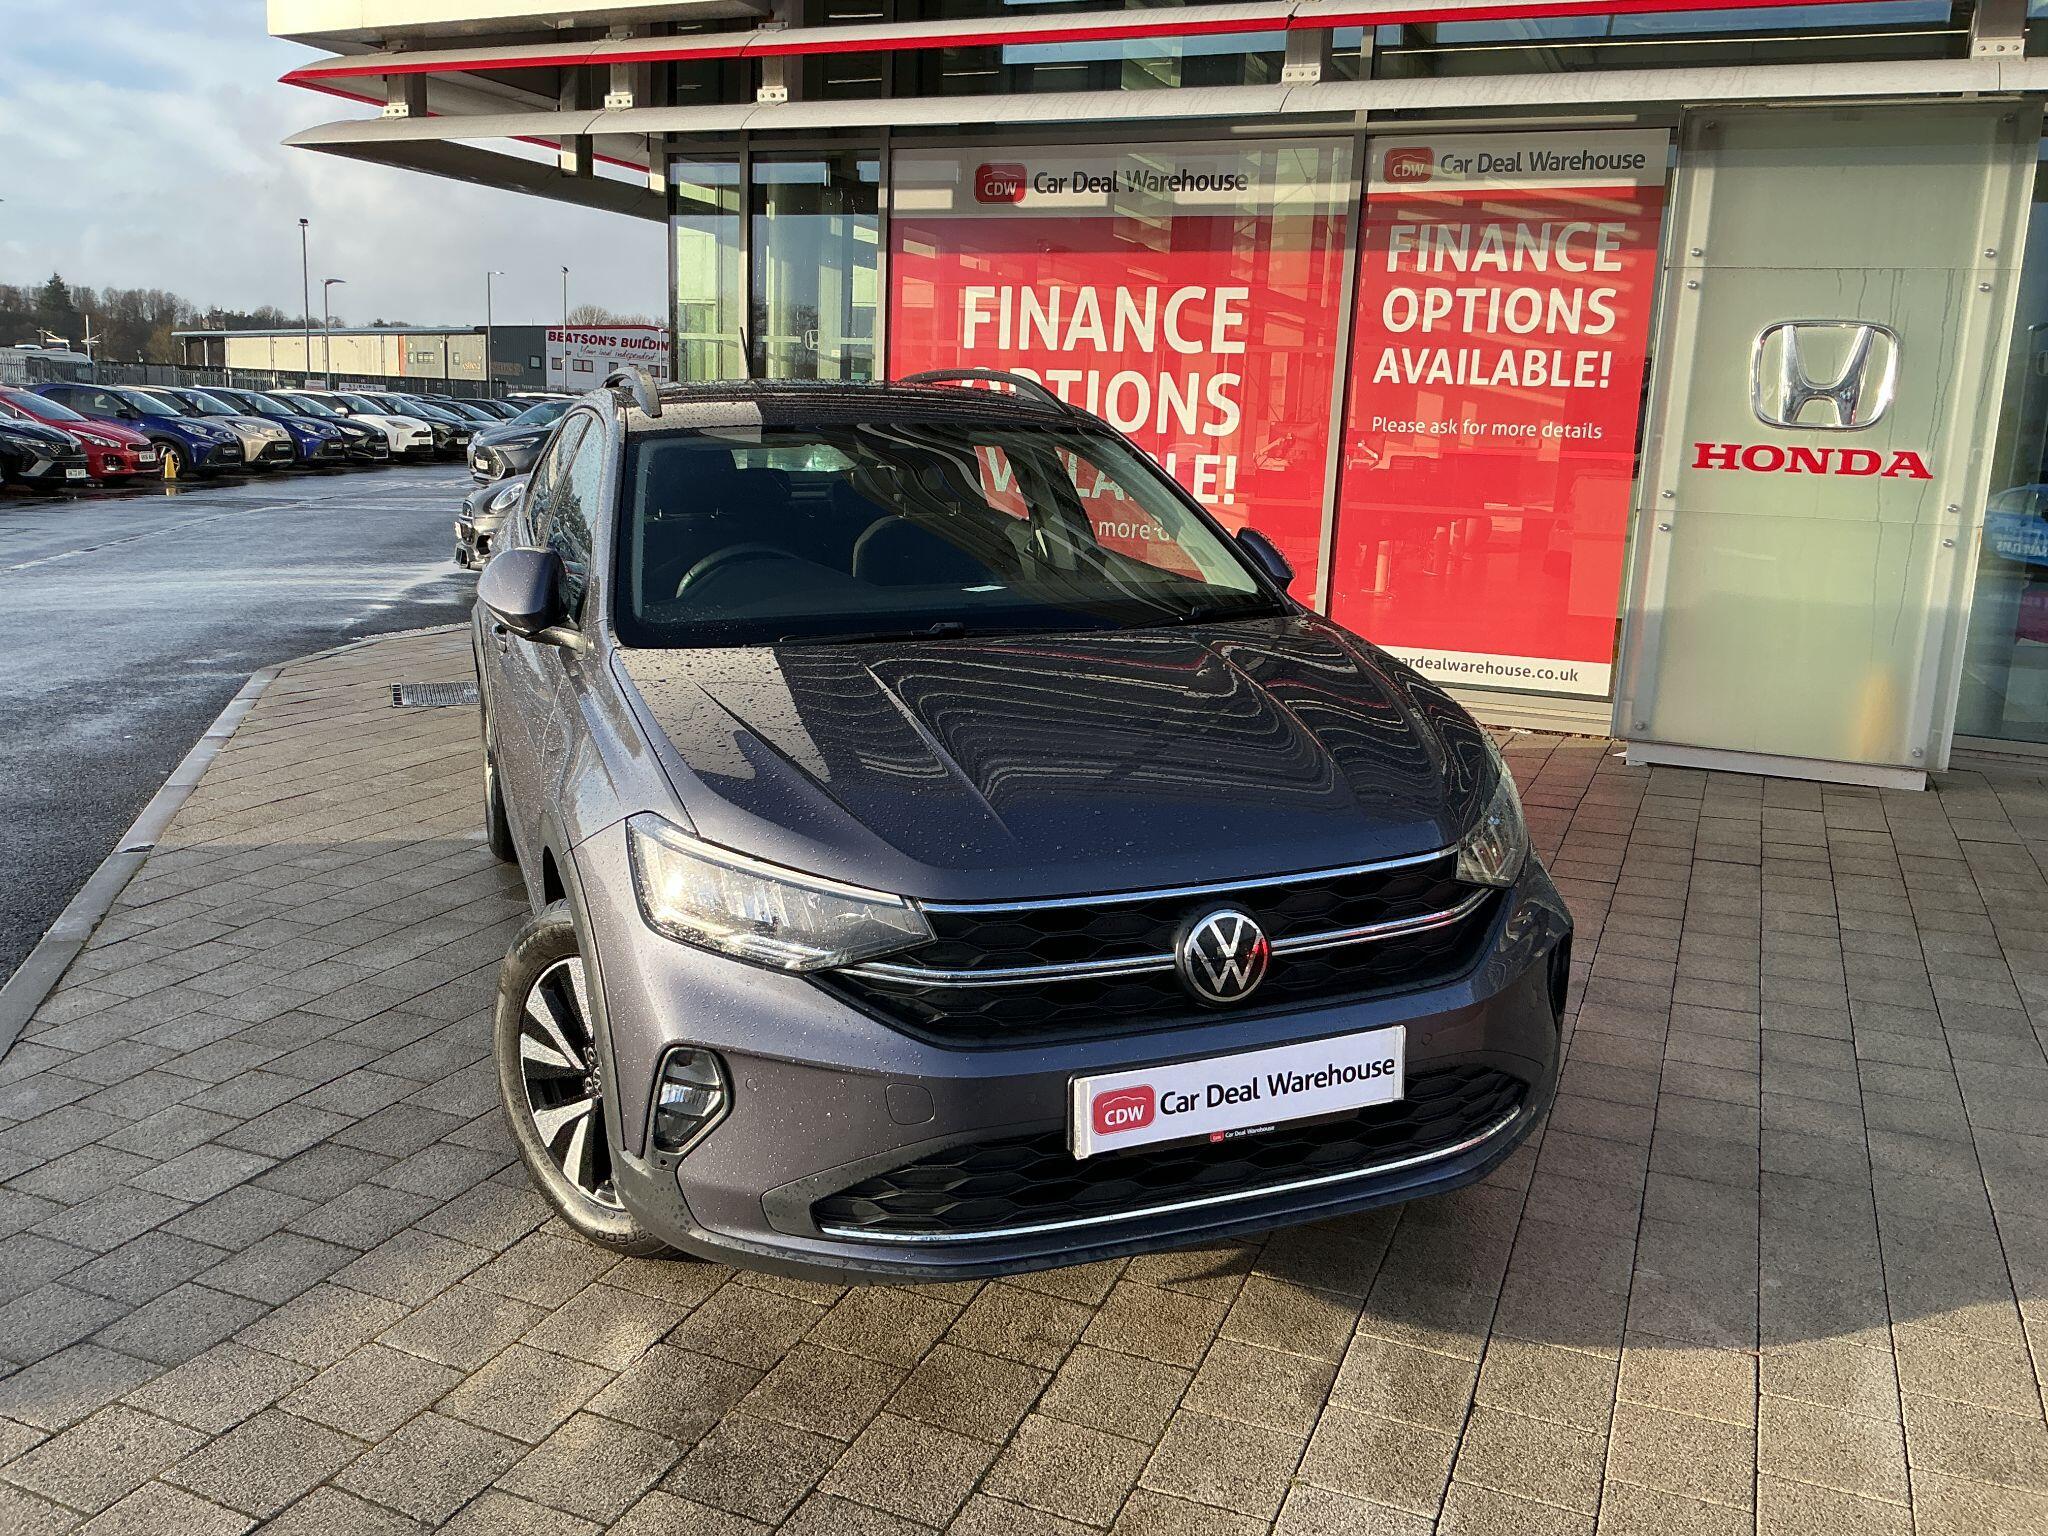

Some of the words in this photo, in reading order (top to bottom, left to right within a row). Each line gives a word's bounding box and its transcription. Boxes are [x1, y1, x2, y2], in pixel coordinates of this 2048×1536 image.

[1392, 163, 1425, 178] CDW
[1441, 154, 1473, 174] Car
[1478, 152, 1523, 173] Deal
[1530, 150, 1646, 172] Warehouse
[984, 182, 1017, 196] CDW
[1034, 172, 1067, 194] Car
[1073, 170, 1119, 194] Deal
[1126, 169, 1249, 192] Warehouse
[1386, 222, 1626, 273] FINANCE
[963, 286, 1249, 354] FINANCE
[1382, 287, 1617, 335] OPTIONS
[548, 331, 617, 347] BEATSON'S
[1373, 347, 1612, 389] AVAILABLE!
[1372, 416, 1426, 433] Please
[1430, 418, 1458, 434] ask
[1462, 418, 1487, 435] for
[1492, 422, 1537, 437] more
[1541, 421, 1602, 439] details
[1691, 443, 1934, 479] HONDA
[1098, 520, 1150, 540] more
[1395, 656, 1579, 682] ardealwarehouse.co.uk
[1104, 1104, 1145, 1126] CDW
[1159, 1091, 1200, 1115] Car
[1206, 1077, 1260, 1108] Deal
[1267, 1058, 1395, 1097] Warehouse
[1247, 1126, 1275, 1135] Warehouse
